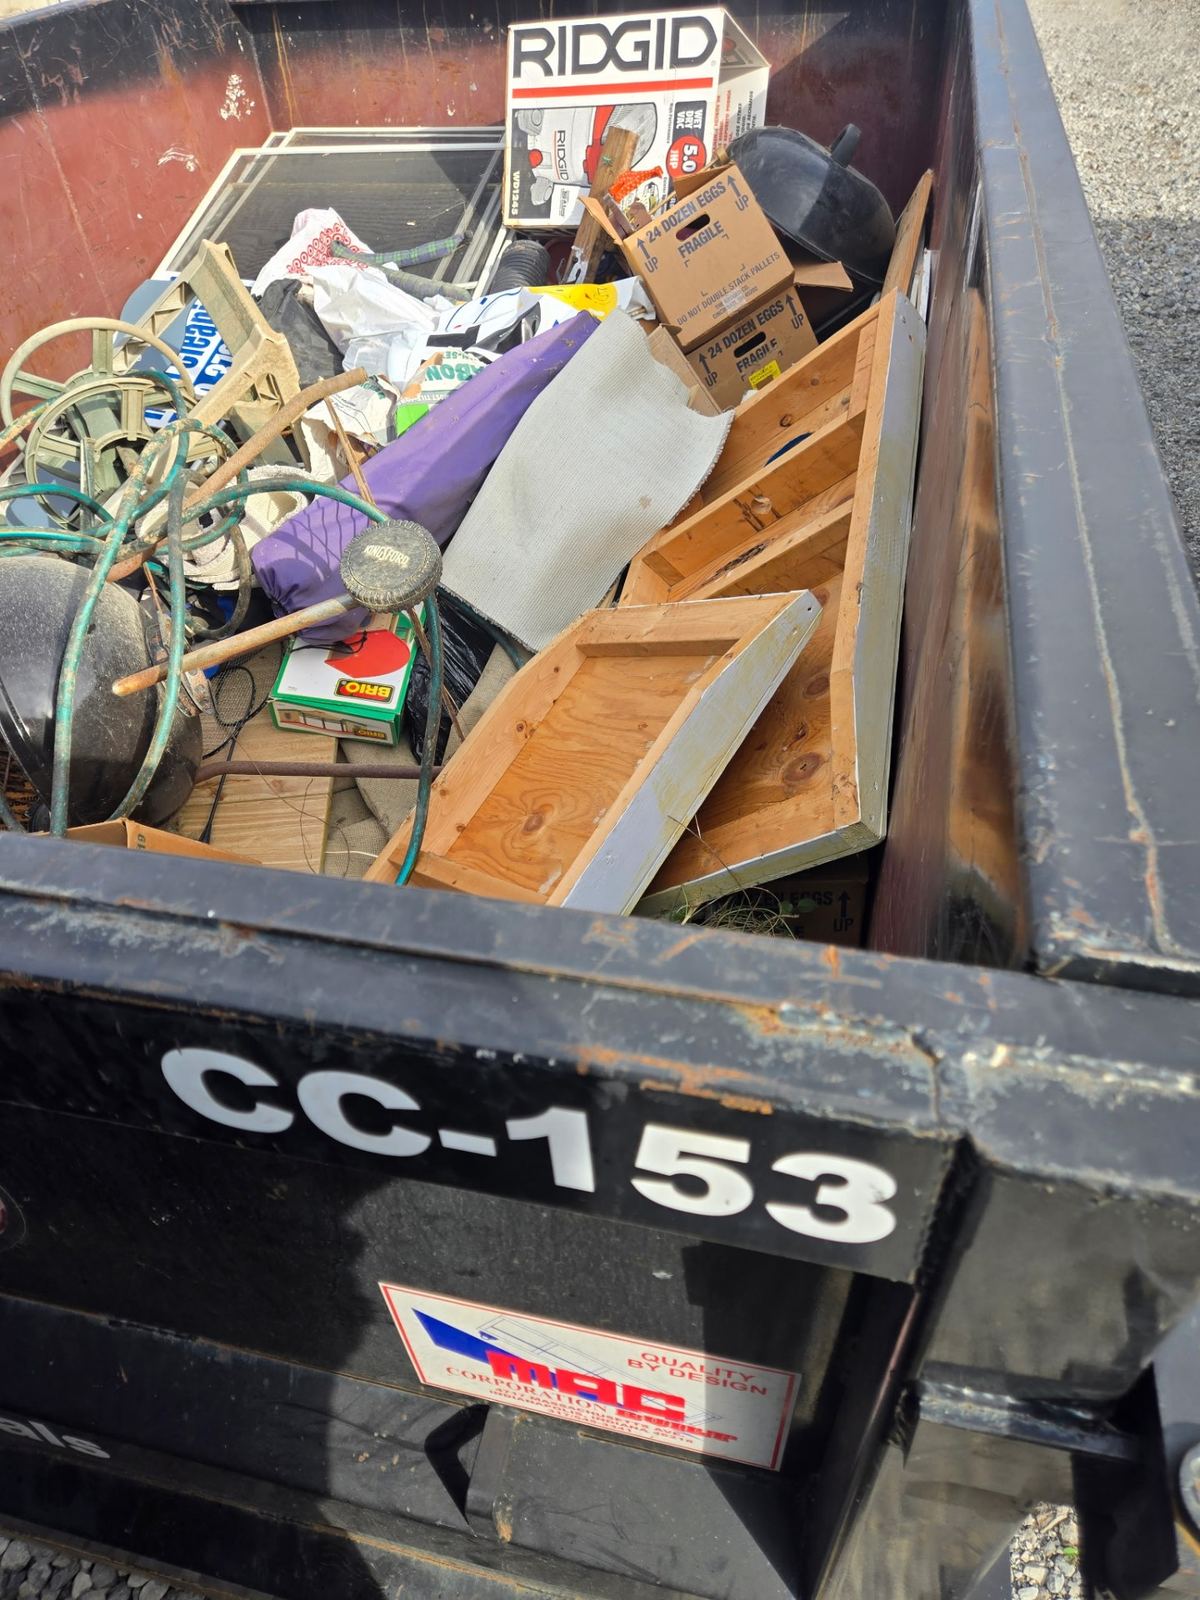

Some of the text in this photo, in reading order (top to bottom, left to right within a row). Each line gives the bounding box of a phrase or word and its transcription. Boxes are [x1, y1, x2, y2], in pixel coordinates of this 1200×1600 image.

[513, 16, 718, 78] RIDGID
[676, 111, 686, 129] VAC
[684, 110, 694, 129] DRY
[692, 109, 703, 129] WET
[557, 130, 569, 181] RIDGID
[682, 144, 698, 173] 5.0
[511, 171, 520, 216] WD1245
[736, 194, 749, 212] UP
[646, 226, 662, 244] 24
[661, 202, 698, 233] DOZEN
[696, 181, 727, 208] EGGS
[678, 220, 724, 258] FRAGILE
[645, 256, 659, 273] UP
[677, 315, 688, 326] DO
[687, 304, 702, 318] NOT
[702, 287, 727, 309] DOUBLE
[728, 271, 751, 291] STACK
[750, 251, 780, 275] PALLETS
[707, 300, 785, 359] 24 DOZEN EGGS
[791, 313, 804, 330] UP
[736, 338, 778, 373] FRAGILE
[705, 371, 718, 388] UP
[363, 544, 410, 566] KINGSFORD
[345, 681, 391, 698] BRIO
[833, 918, 853, 932] UP
[160, 1047, 897, 1244] CC-153
[627, 1358, 767, 1397] BY DESIGN
[640, 1352, 756, 1383] QUALITY
[446, 1366, 608, 1412] CORPORATION
[484, 1350, 685, 1423] MAC
